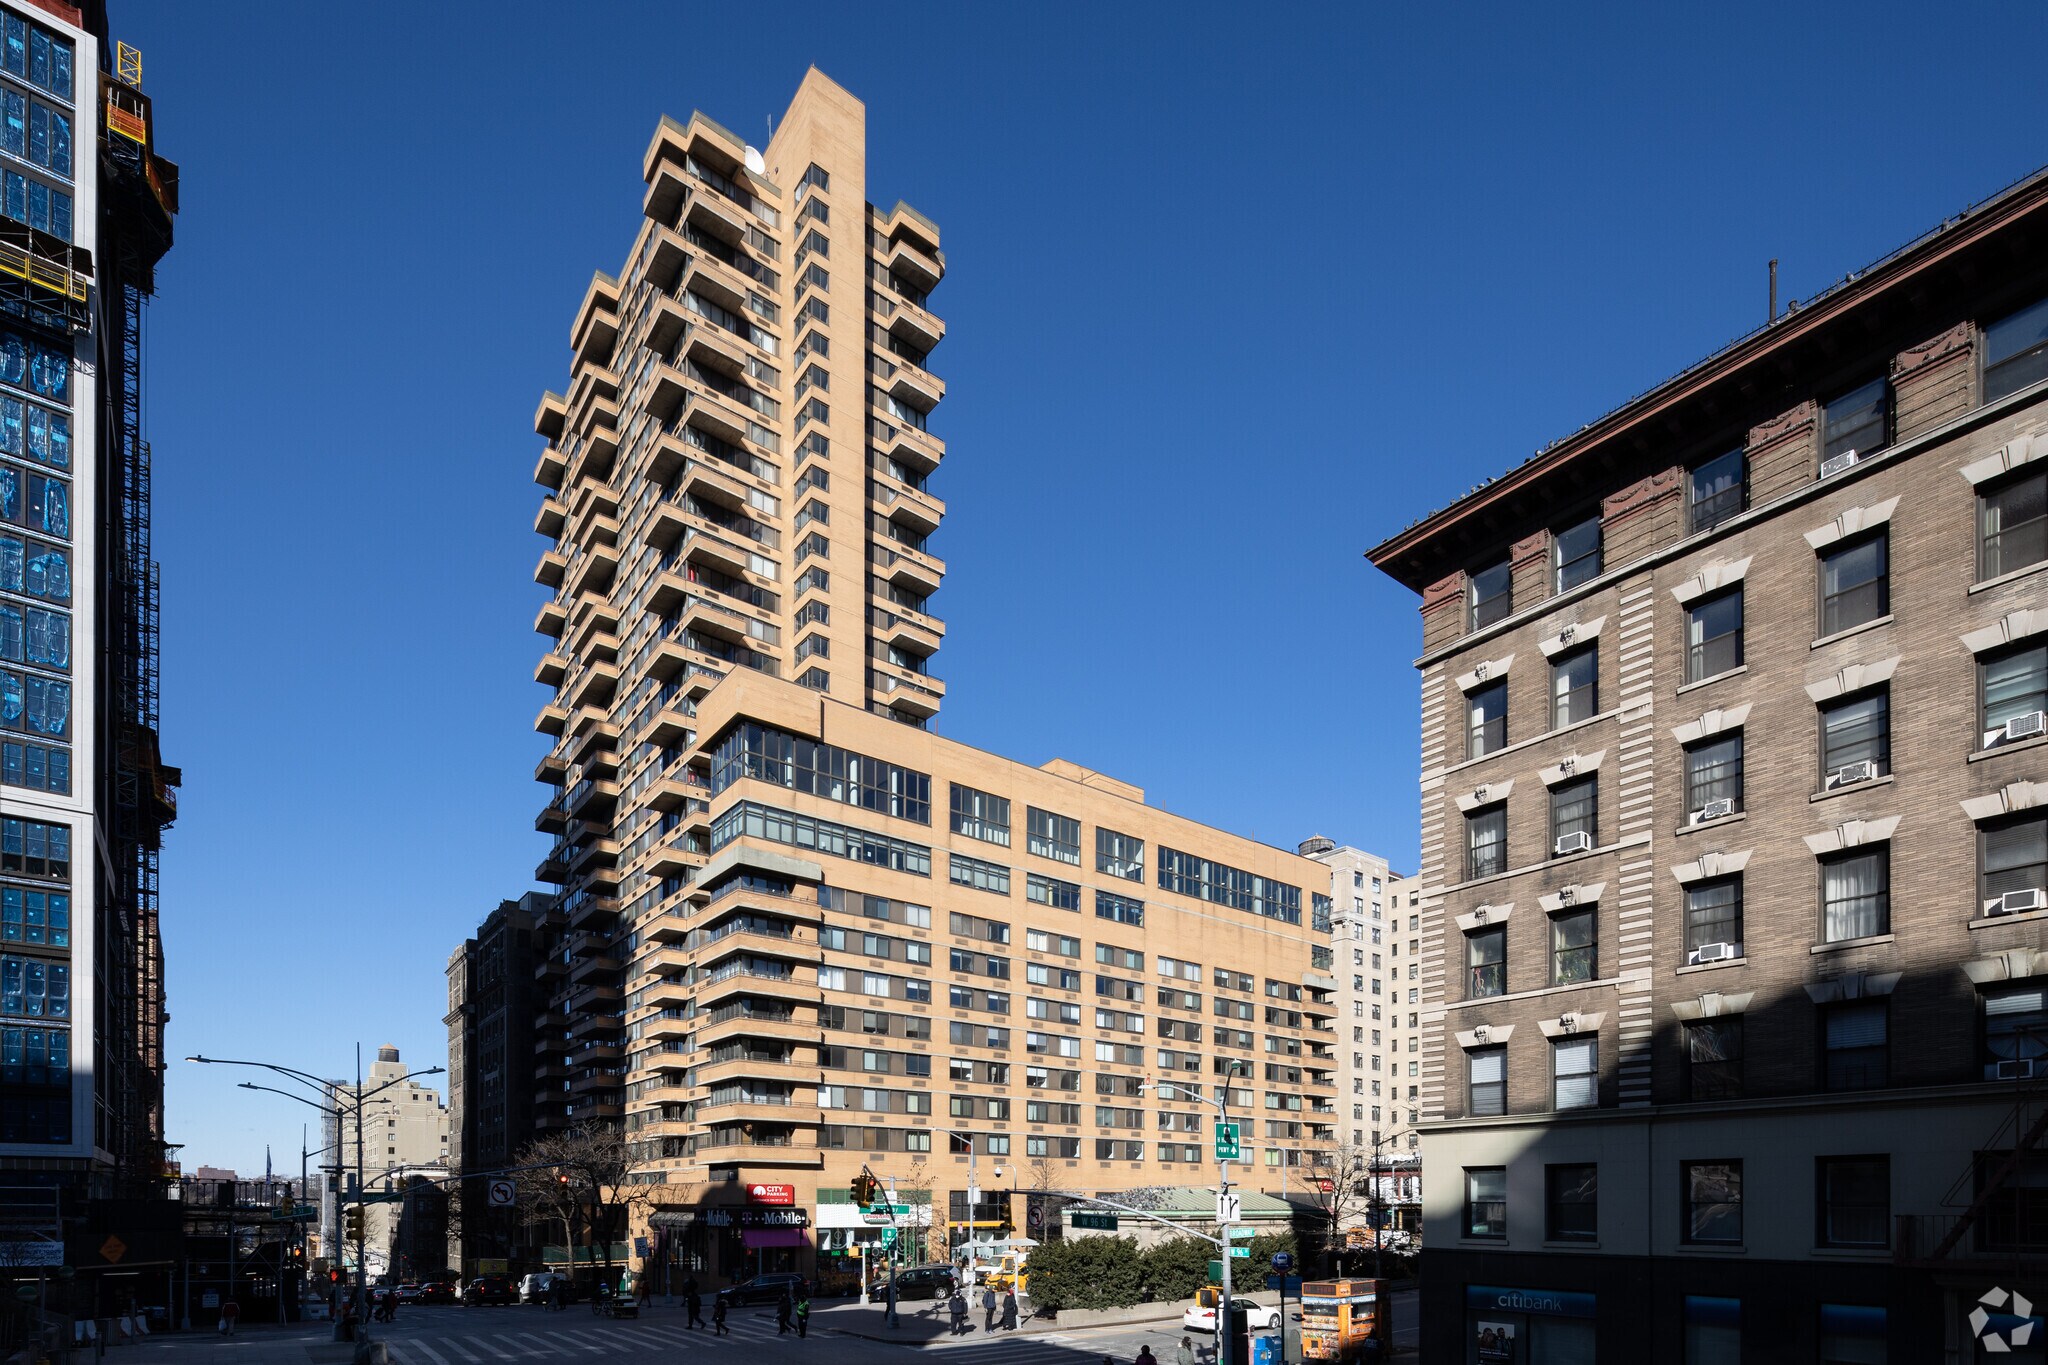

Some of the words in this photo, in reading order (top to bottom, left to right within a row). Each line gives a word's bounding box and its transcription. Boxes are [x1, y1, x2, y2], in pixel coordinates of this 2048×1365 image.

[706, 1210, 731, 1226] Mobile
[764, 1212, 802, 1224] Mobile
[1082, 1217, 1088, 1226] W
[1090, 1217, 1099, 1227] 96
[1100, 1218, 1108, 1227] St
[1237, 1248, 1244, 1256] 96
[1498, 1291, 1562, 1311] citibank
